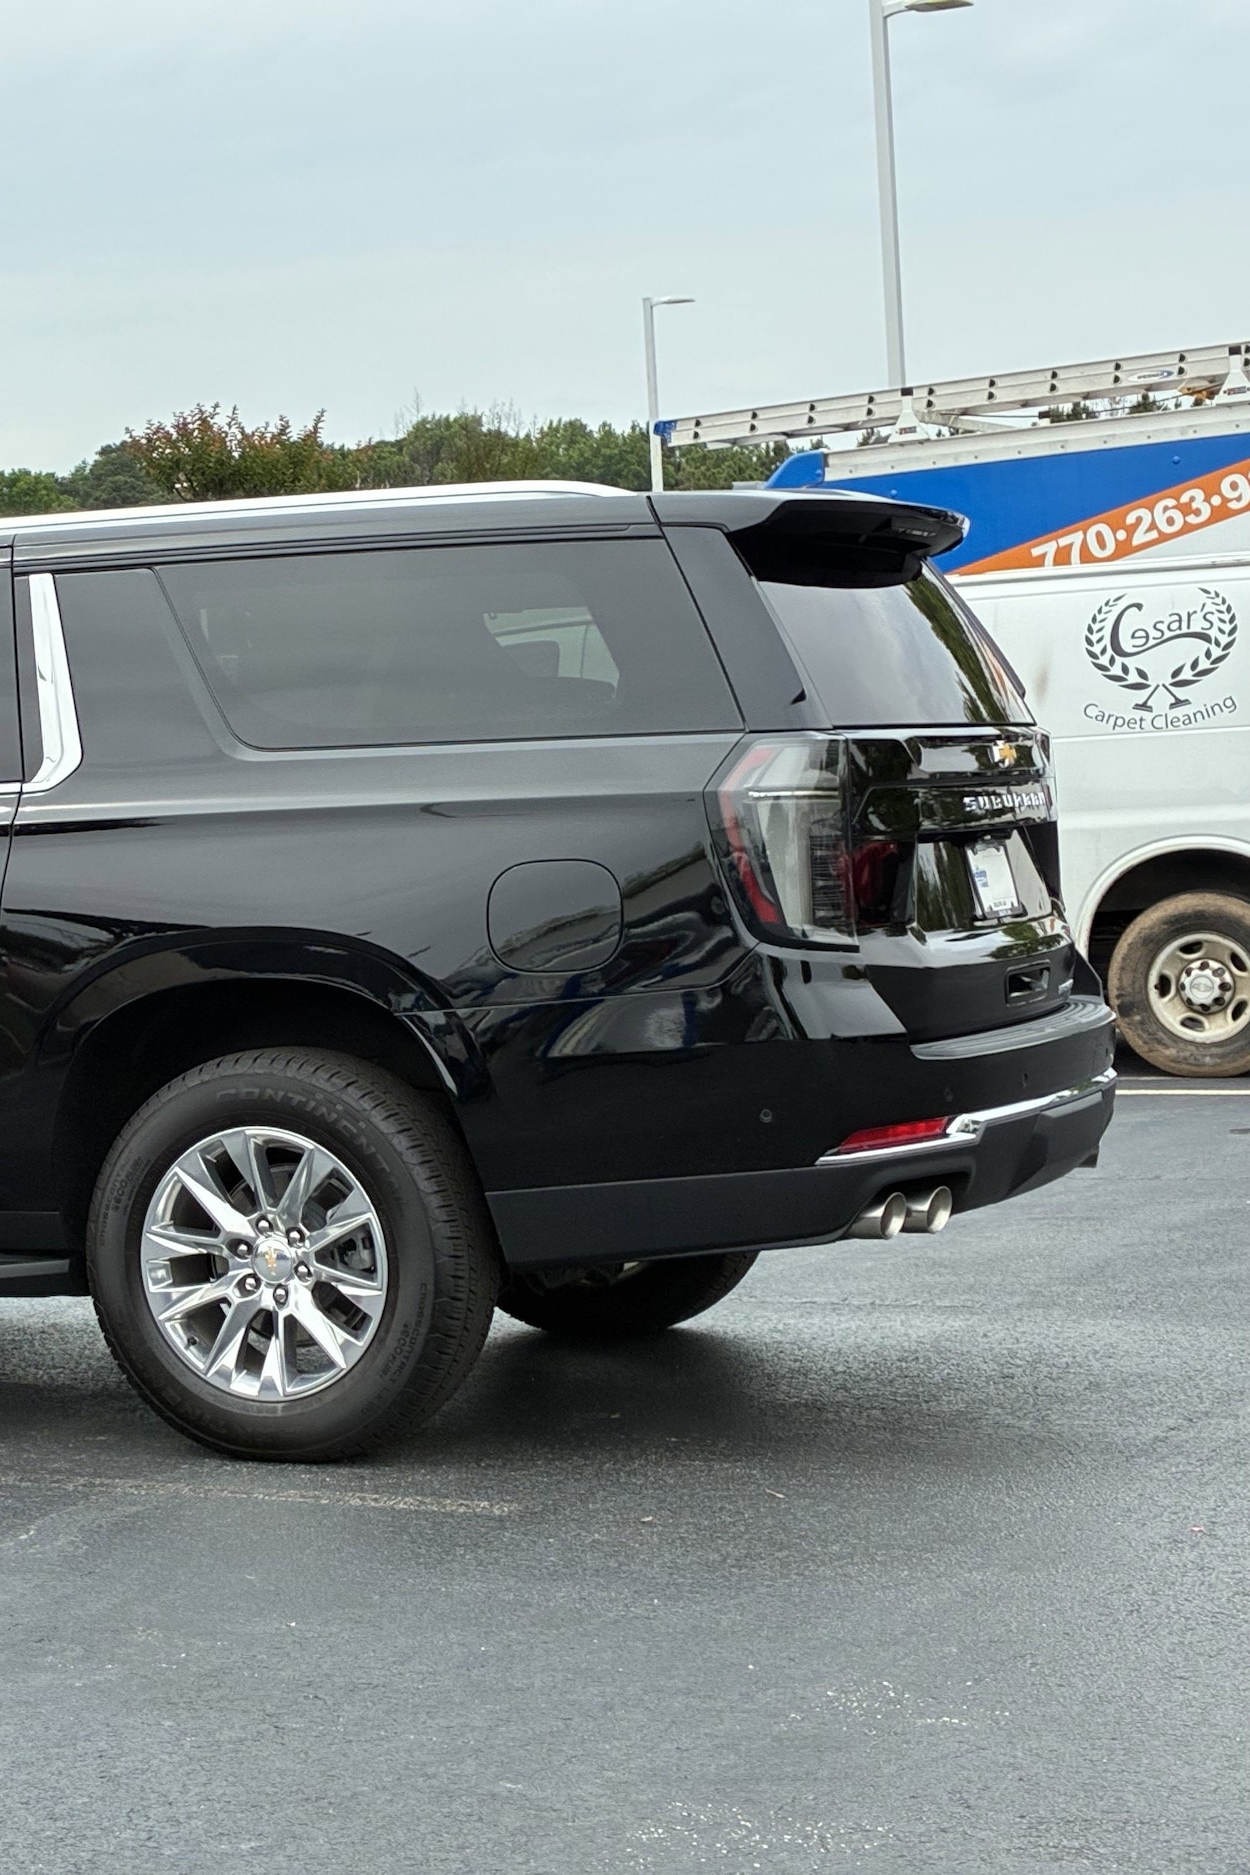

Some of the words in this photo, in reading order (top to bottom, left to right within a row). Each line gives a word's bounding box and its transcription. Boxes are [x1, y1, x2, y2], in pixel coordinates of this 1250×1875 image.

[1110, 602, 1216, 658] Cesar's
[1083, 703, 1146, 731] Carpet
[1151, 695, 1238, 730] Cleaning
